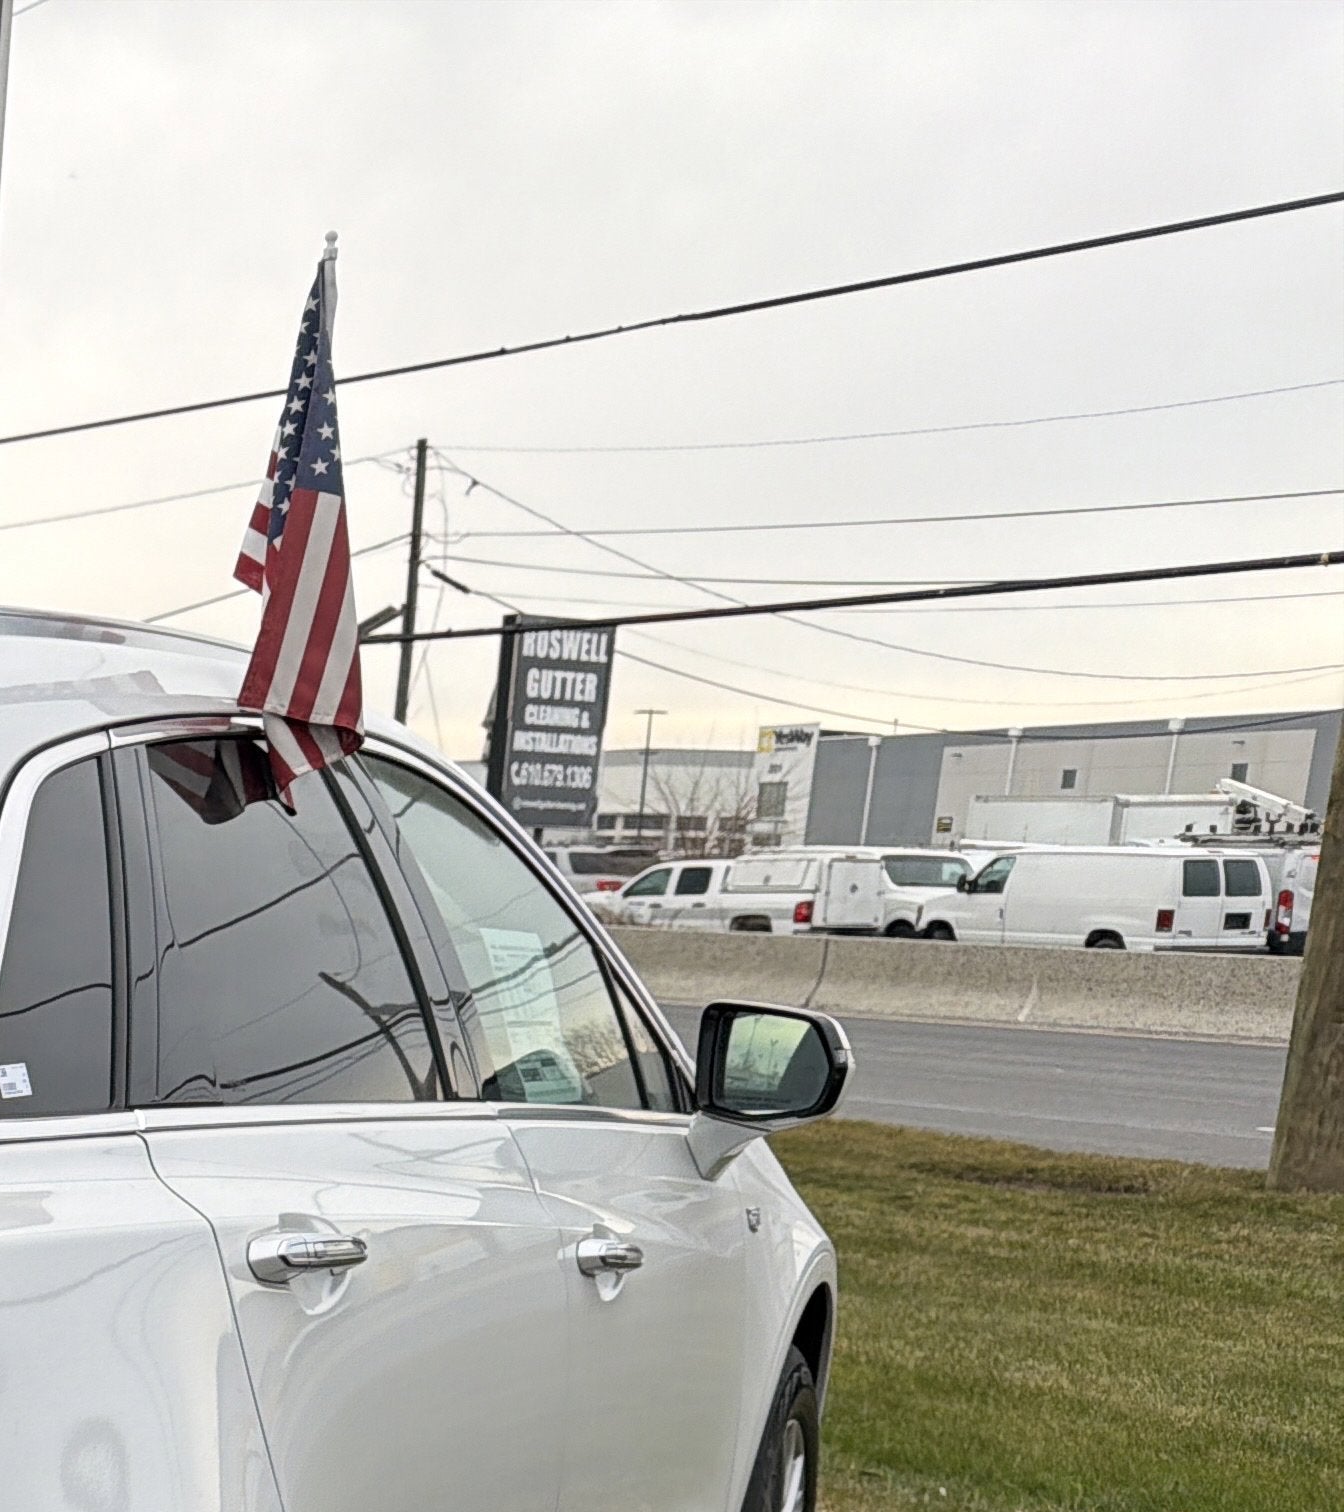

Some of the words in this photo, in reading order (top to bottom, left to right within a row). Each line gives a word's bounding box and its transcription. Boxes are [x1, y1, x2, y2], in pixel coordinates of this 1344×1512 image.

[522, 629, 609, 664] ROSWELL
[526, 667, 598, 703] GUTTER
[524, 704, 580, 728] CLEANING
